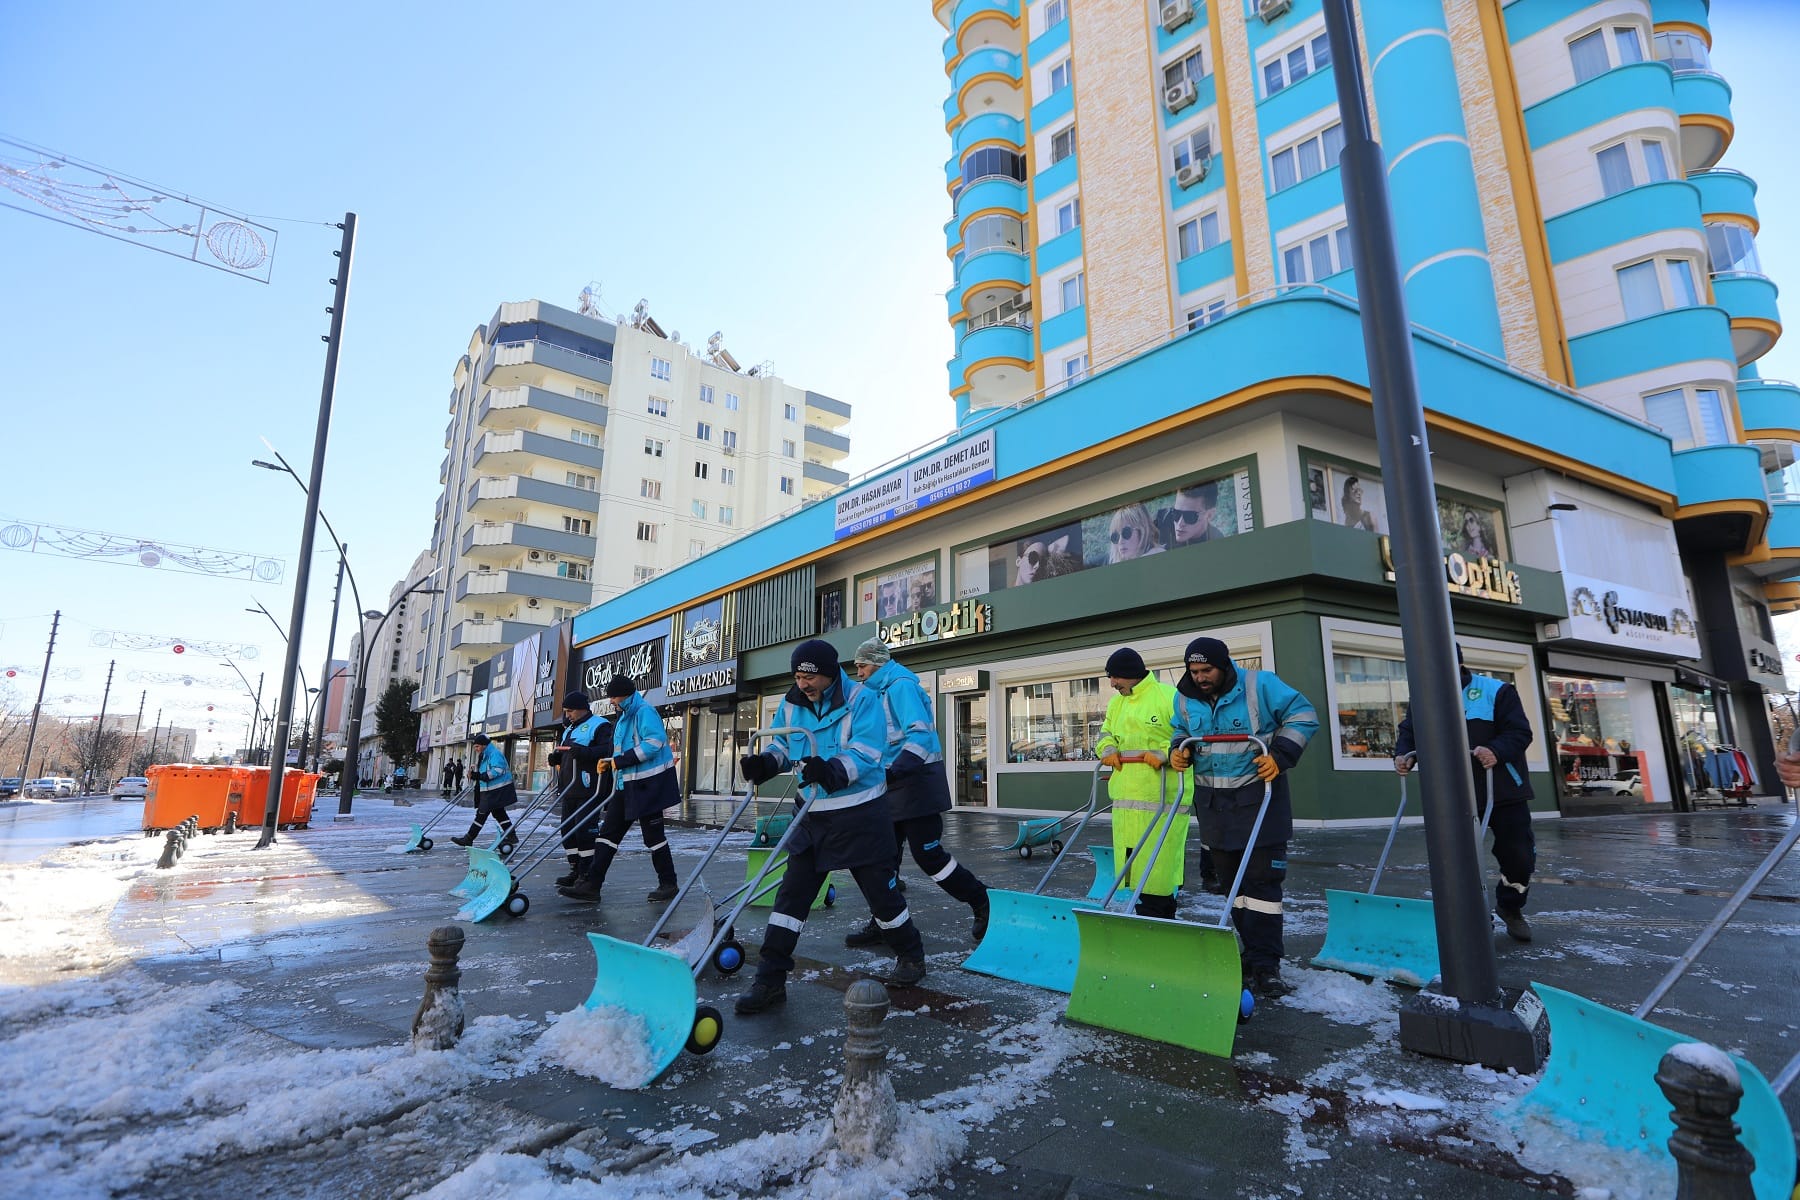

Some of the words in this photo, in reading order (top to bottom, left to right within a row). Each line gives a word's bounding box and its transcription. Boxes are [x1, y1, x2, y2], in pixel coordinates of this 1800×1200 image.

[914, 461, 943, 482] UZM.DR.
[945, 449, 968, 470] DEMET
[970, 439, 990, 459] ALICI
[861, 486, 881, 504] HASAN
[882, 478, 902, 496] BAYAR
[960, 586, 980, 597] PRADA
[689, 668, 732, 693] NAZENDE
